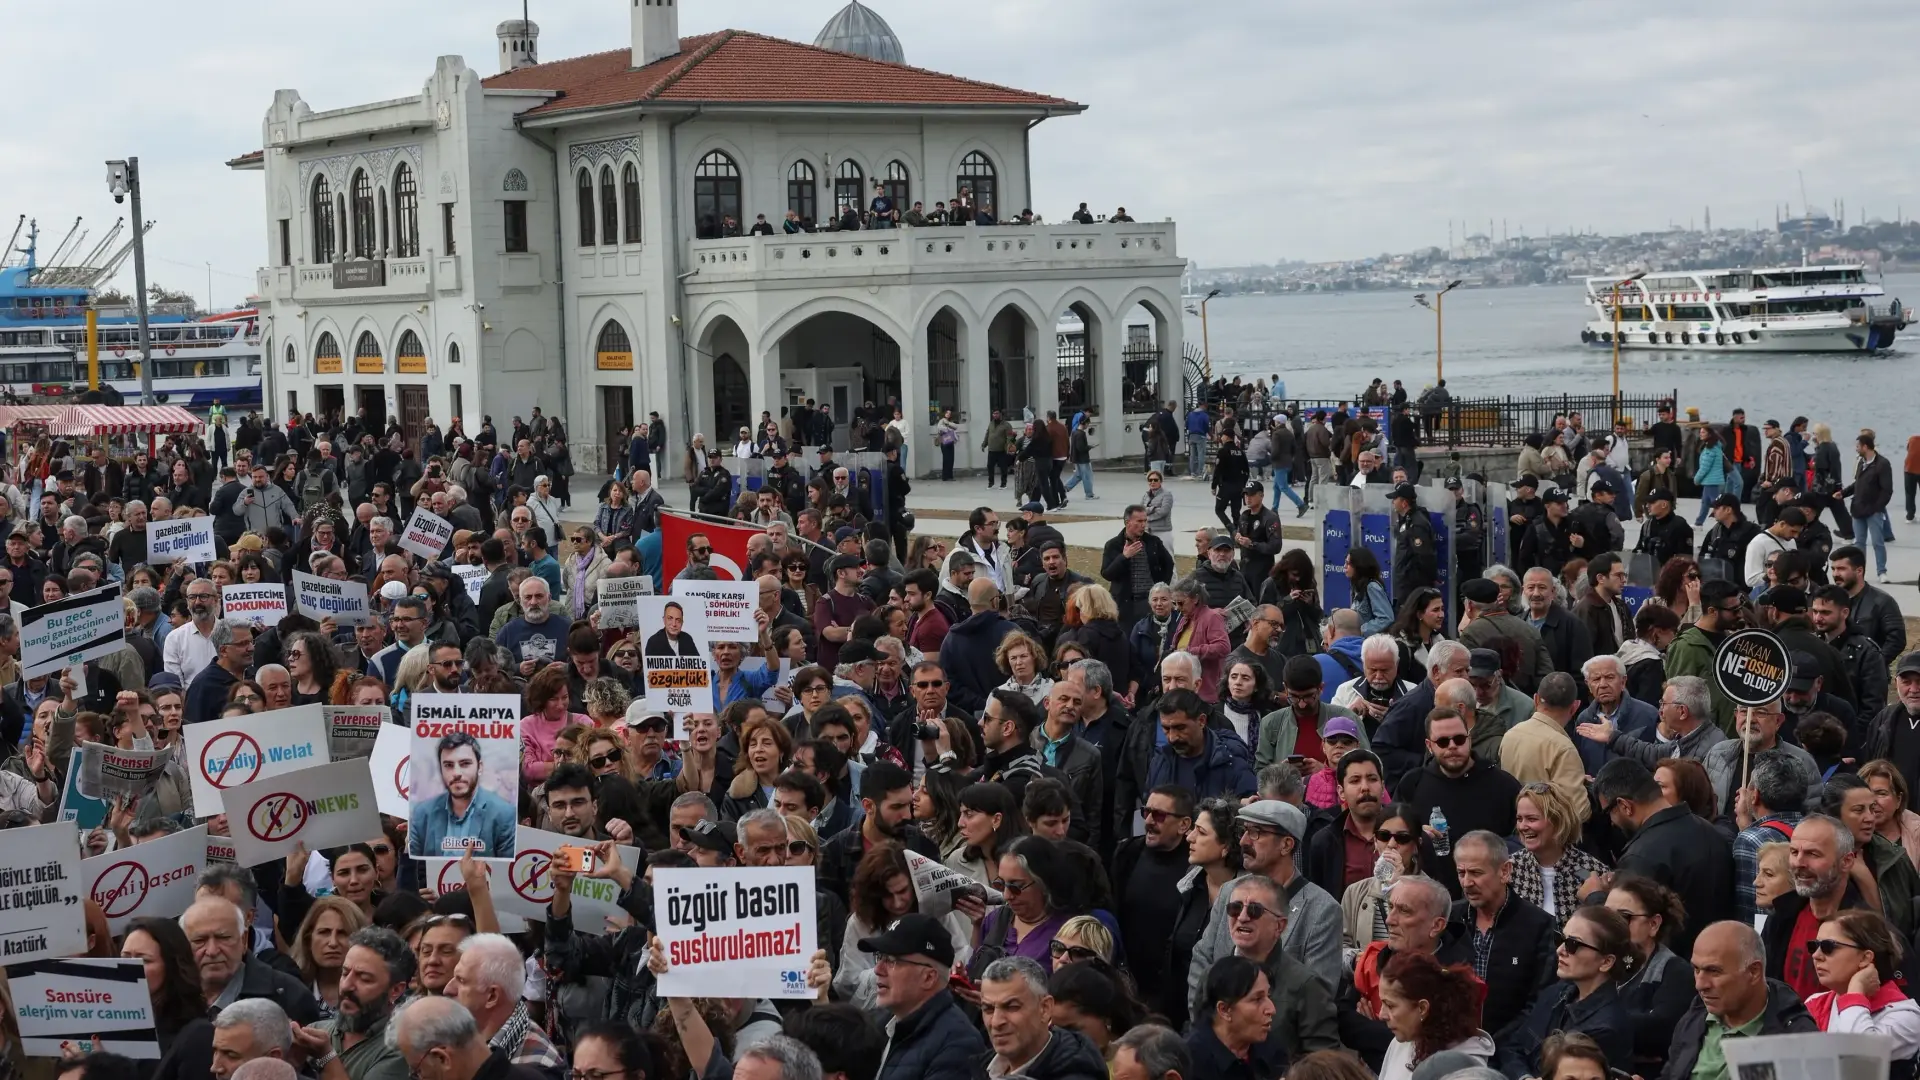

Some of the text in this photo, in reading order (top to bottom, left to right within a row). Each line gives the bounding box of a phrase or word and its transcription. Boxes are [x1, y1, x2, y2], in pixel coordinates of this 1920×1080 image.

[156, 522, 192, 540] gazetecilik
[414, 514, 438, 533] özgür
[153, 531, 209, 554] suç değildir!
[225, 589, 285, 602] GAZETECİME
[301, 580, 342, 595] gazetecilik
[722, 592, 745, 601] KARŞI
[226, 601, 285, 612] DOKUNMA!
[300, 594, 362, 613] suç değildir!
[709, 600, 750, 609] SÖMÜRÜYE
[47, 609, 92, 629] Bu gece
[713, 609, 740, 618] BİRLİK!
[24, 611, 119, 648] hangi gazetecinin evi
[50, 628, 98, 650] basılacak?
[1734, 638, 1771, 662] HAKAN
[647, 656, 707, 670] MURAT AĞIREL'e
[1722, 651, 1748, 678] NE
[650, 671, 707, 688] özgürlük!
[1743, 672, 1776, 694] OLDU?
[334, 711, 382, 726] evrensel
[417, 704, 515, 720] İSMAİL ARI'YA
[416, 720, 515, 739] ÖZGÜRLÜK
[103, 754, 154, 769] evrensel
[268, 742, 314, 763] Welat
[293, 793, 359, 820] JNNEWS
[34, 861, 68, 883] DEĞİL,
[935, 879, 959, 893] zehir
[667, 881, 800, 932] özgür basın
[4, 934, 48, 956] Atatürk
[670, 922, 801, 966] susturulamaz!
[45, 988, 112, 1004] Sansüre
[19, 1004, 146, 1020] alerjim var canım!
